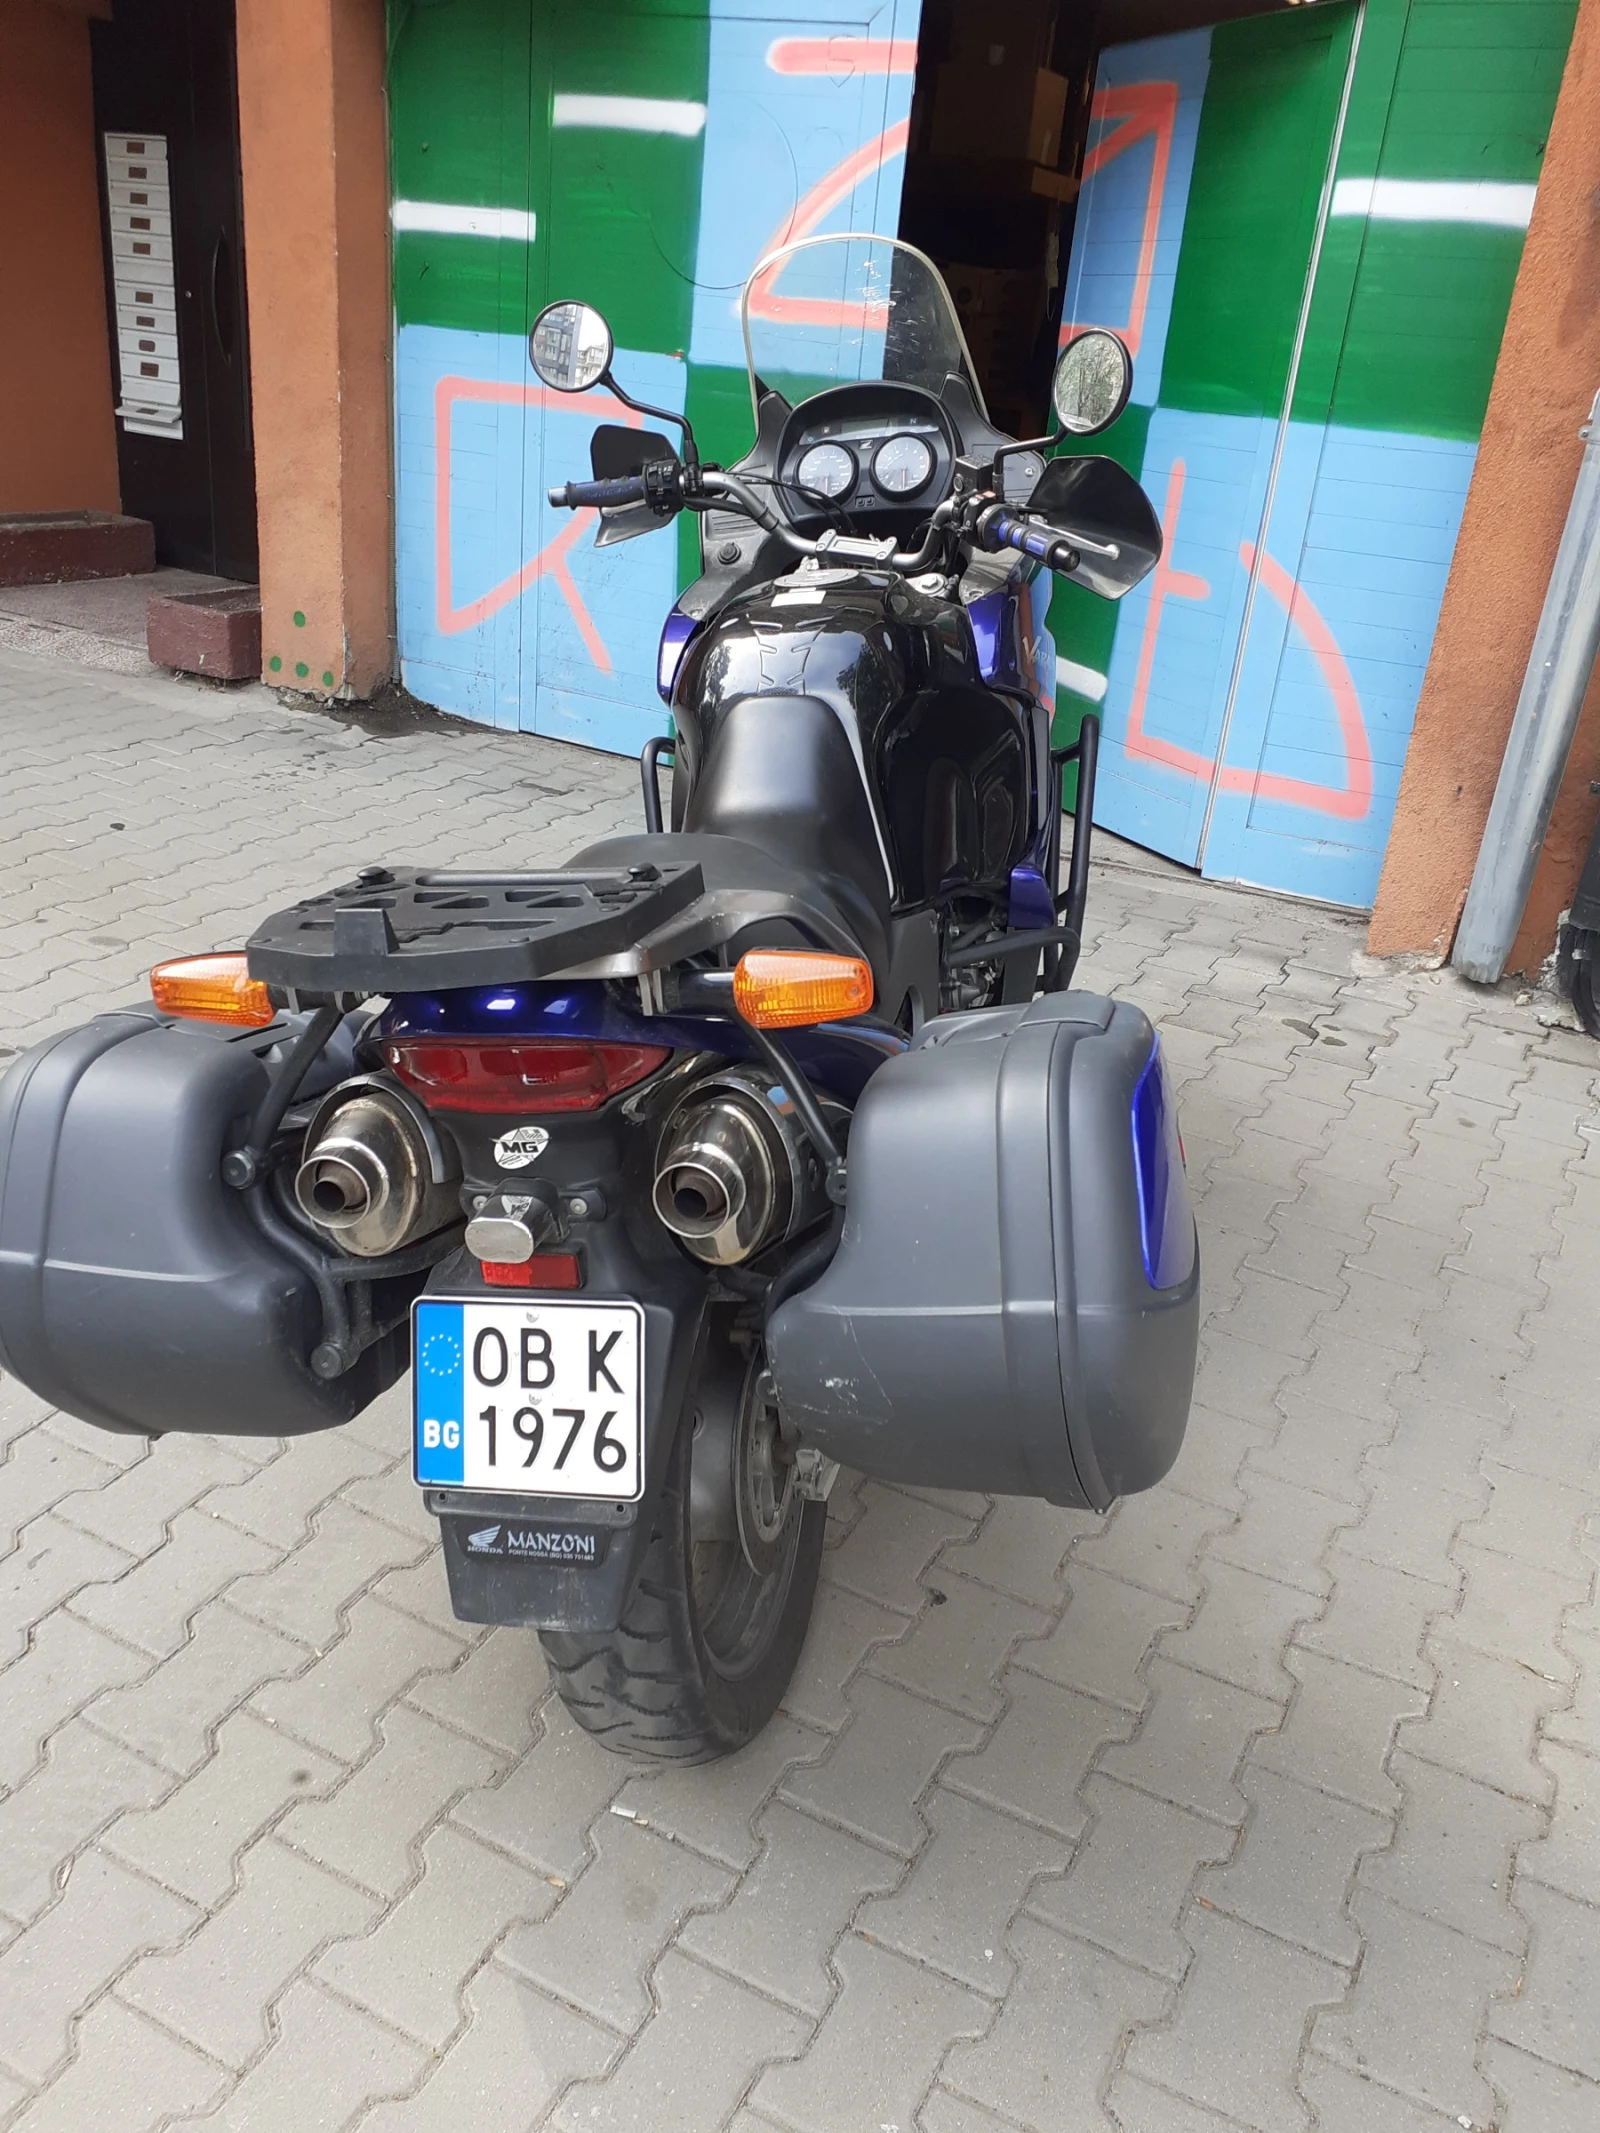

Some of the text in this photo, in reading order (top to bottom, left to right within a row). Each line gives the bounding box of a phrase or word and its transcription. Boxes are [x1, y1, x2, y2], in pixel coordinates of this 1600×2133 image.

[500, 1141, 539, 1154] MG
[472, 1326, 624, 1395] OB K
[423, 1419, 461, 1450] BG
[478, 1405, 628, 1474] 1976
[467, 1545, 503, 1554] HONDA
[507, 1530, 595, 1553] MANZONI
